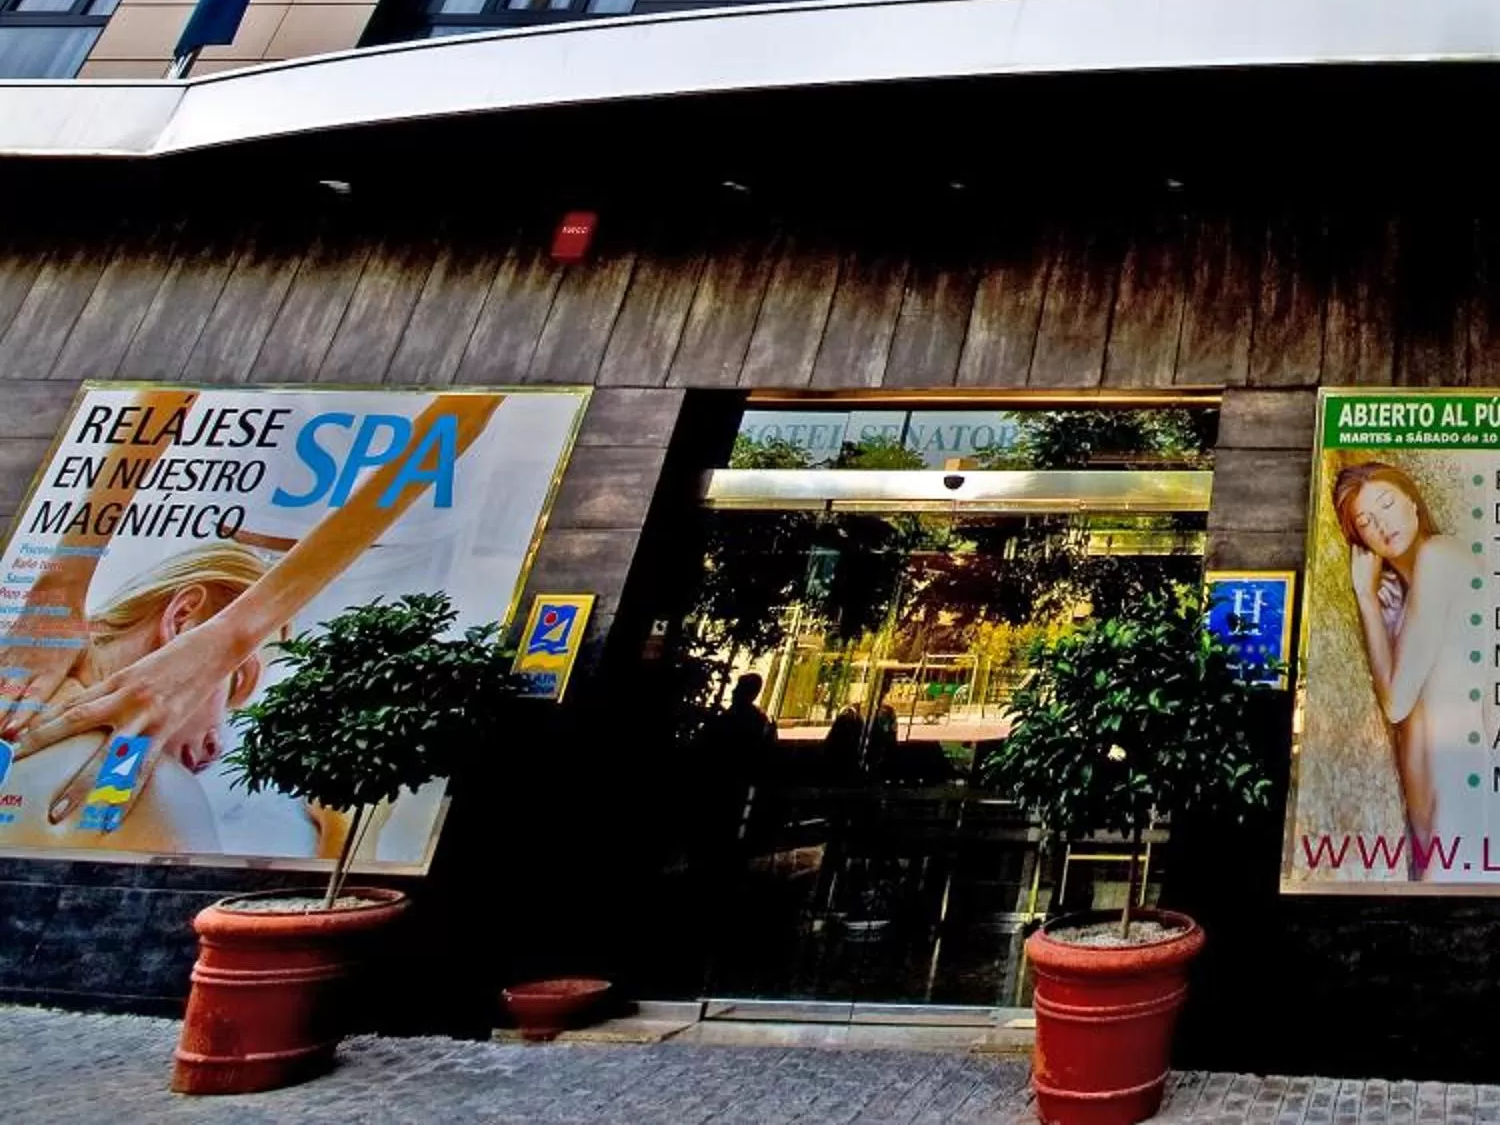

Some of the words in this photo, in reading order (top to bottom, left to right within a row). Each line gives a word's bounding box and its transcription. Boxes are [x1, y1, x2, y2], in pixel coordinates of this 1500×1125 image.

[76, 395, 291, 449] RELÁJESE
[1339, 402, 1435, 427] ABIERTO
[1441, 402, 1468, 427] AL
[1339, 431, 1392, 444] MARTES
[1405, 430, 1460, 444] SÁBADO
[1462, 431, 1479, 444] de
[1482, 432, 1498, 444] 10
[52, 456, 106, 489] EN
[106, 457, 266, 493] NUESTRO
[271, 412, 459, 509] SPA
[29, 492, 246, 540] MAGNÍFICO
